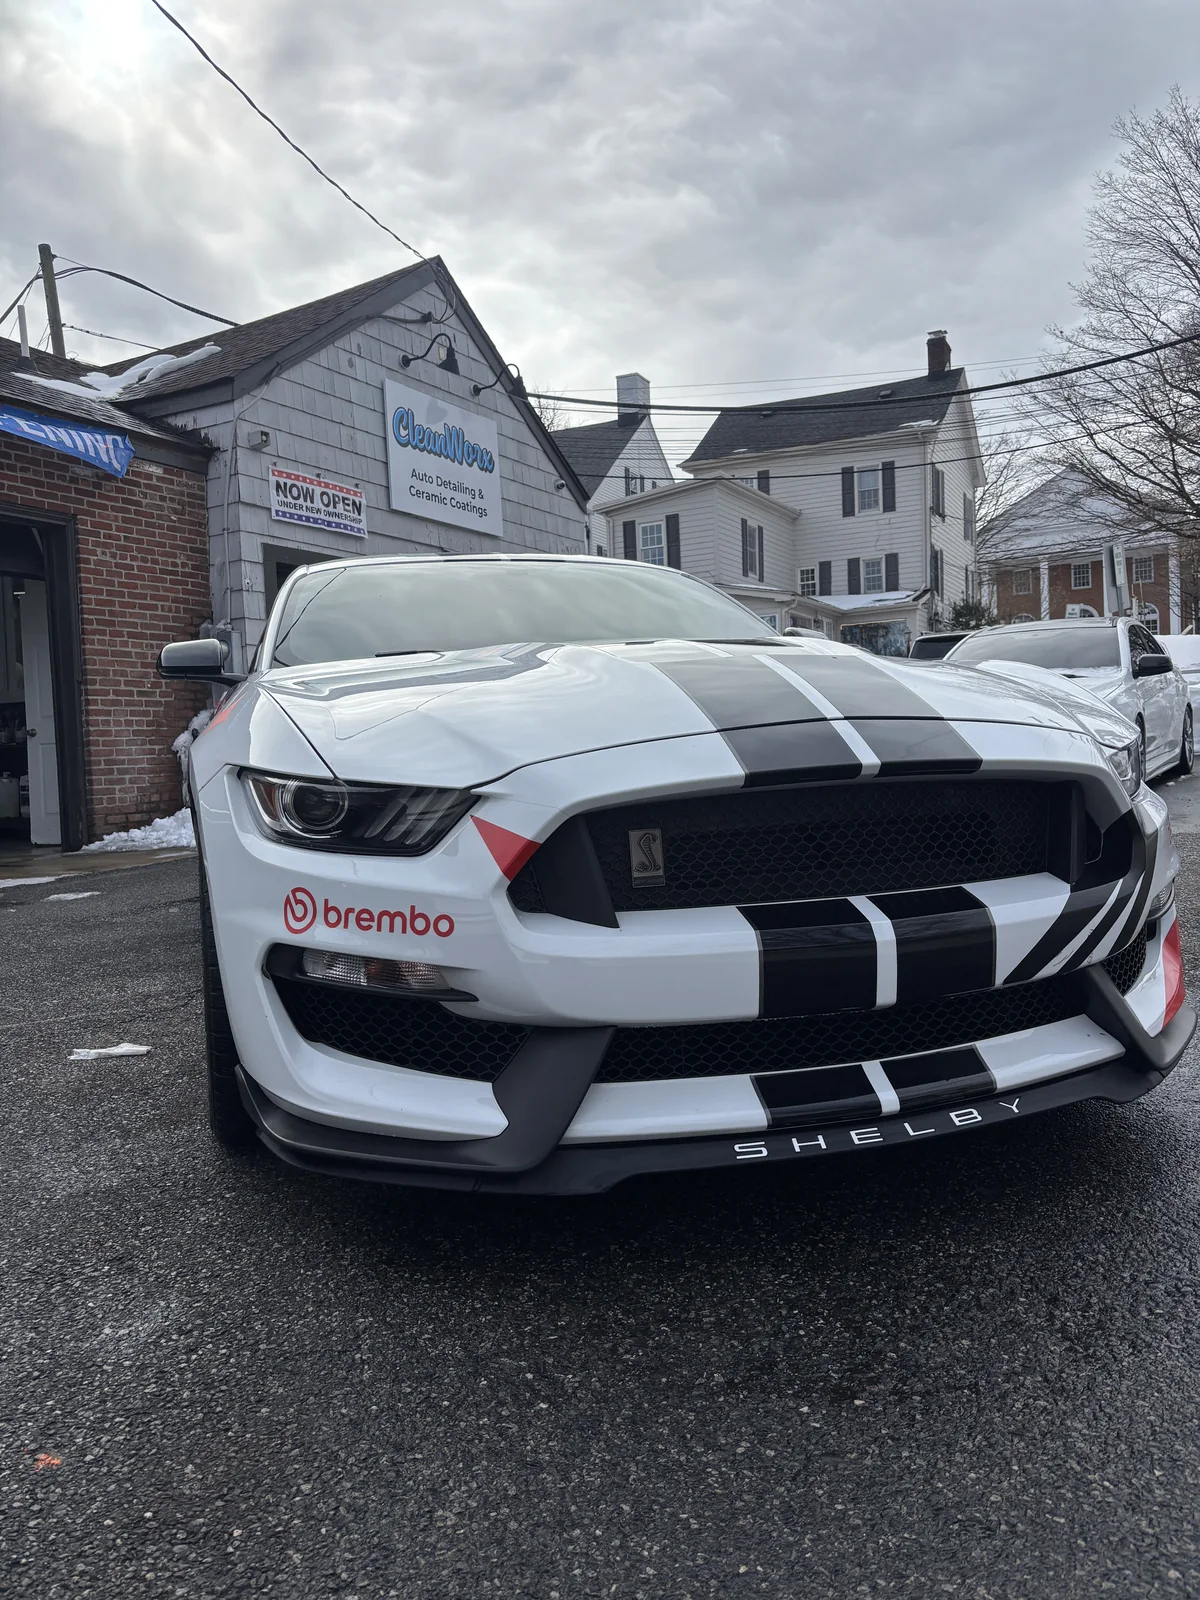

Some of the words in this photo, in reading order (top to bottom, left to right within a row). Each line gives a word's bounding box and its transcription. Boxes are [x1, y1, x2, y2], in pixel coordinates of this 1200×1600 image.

[0, 413, 125, 472] ENING
[392, 406, 495, 474] CleanWorx
[275, 479, 315, 504] NOW
[319, 490, 363, 517] OPEN
[408, 485, 448, 506] Ceramic
[449, 498, 488, 518] Coatings
[410, 468, 434, 485] Auto
[436, 476, 476, 500] Detailing
[477, 488, 485, 500] &
[277, 499, 304, 512] UNDER
[305, 505, 323, 516] NEW
[323, 509, 363, 526] OWNERSHIP
[323, 898, 455, 938] brembo
[733, 1097, 1022, 1160] SHELBY
